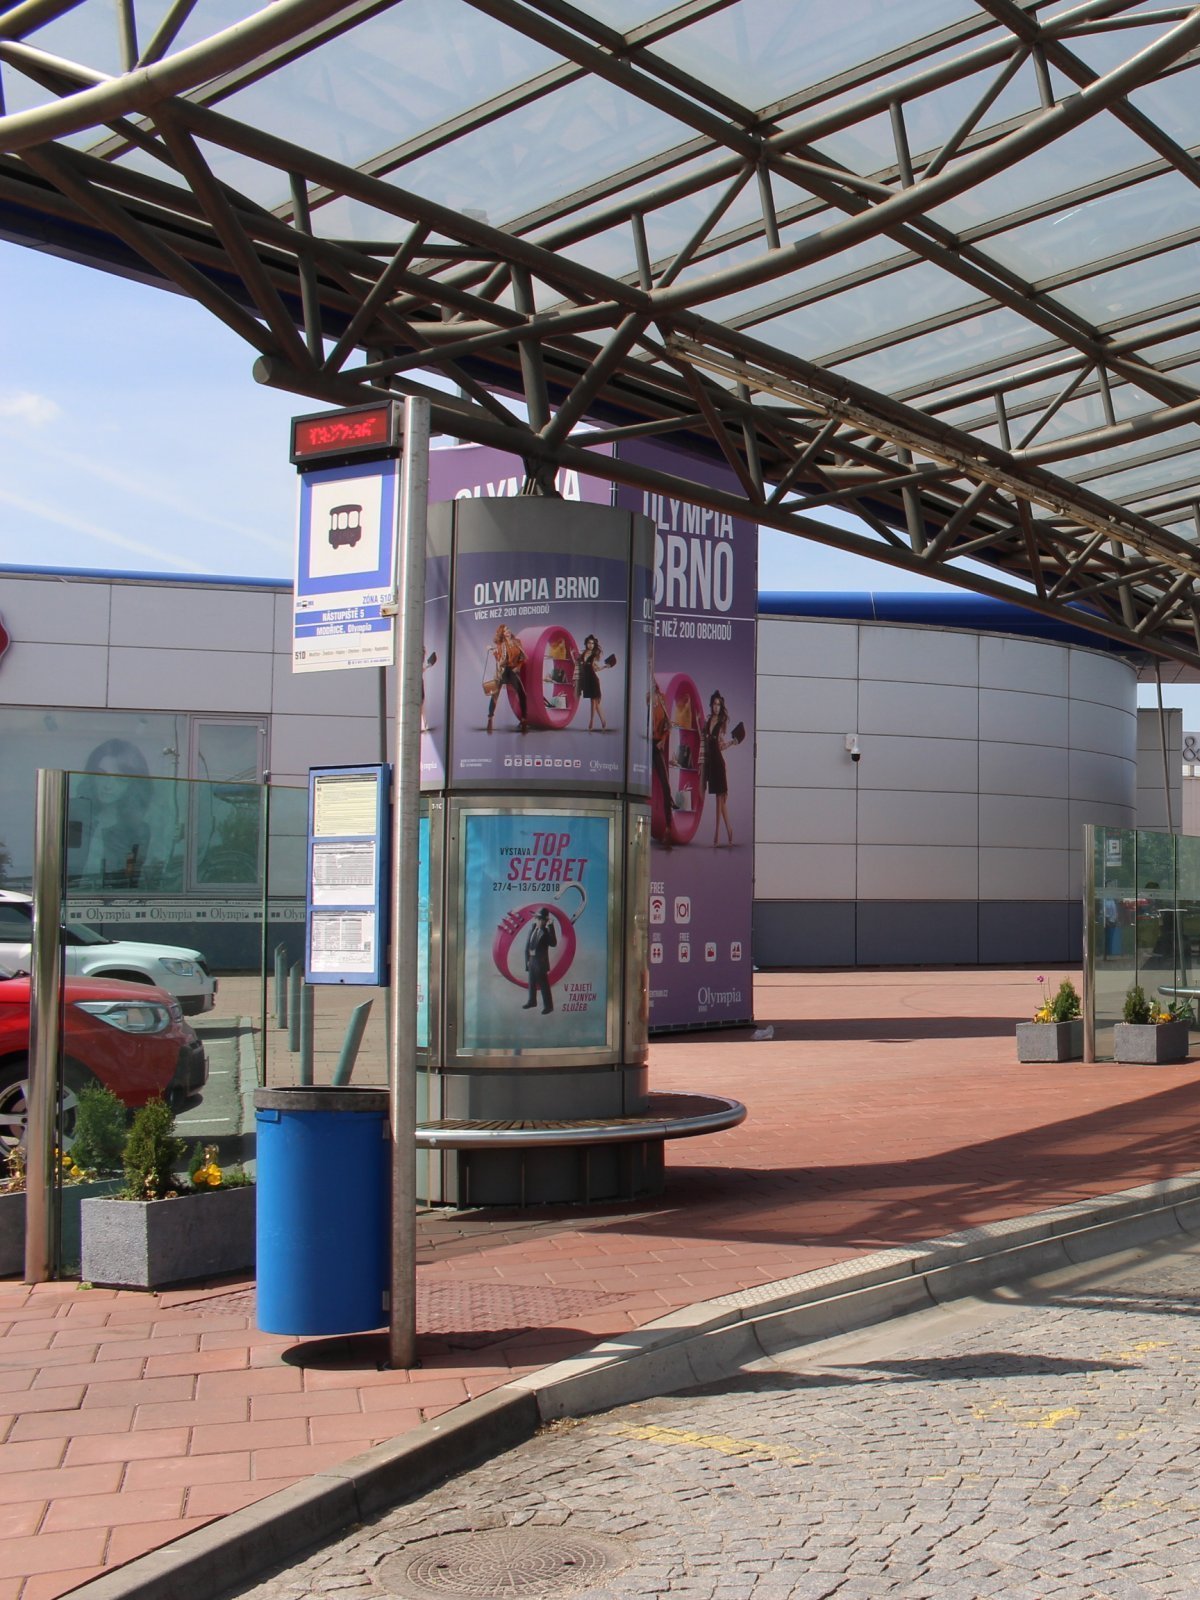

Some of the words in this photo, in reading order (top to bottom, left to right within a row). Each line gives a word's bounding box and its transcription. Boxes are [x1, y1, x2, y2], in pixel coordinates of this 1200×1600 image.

[654, 533, 734, 612] BRNO
[474, 577, 549, 606] OLYMPIA
[555, 576, 599, 599] BRNO
[360, 609, 365, 618] 5
[474, 608, 489, 620] VÍCE
[489, 605, 503, 619] NEŽ
[504, 605, 518, 617] 200
[518, 603, 550, 616] OBCHODŮ
[661, 618, 678, 638] NEŽ
[679, 621, 695, 639] 200
[696, 621, 732, 641] OBCHODŮ
[295, 651, 306, 660] 510
[500, 846, 531, 856] VÝSTAVA
[532, 832, 571, 857] TOP
[508, 858, 588, 882] SECRET
[650, 882, 665, 894] FREE
[86, 907, 131, 921] Olympia
[150, 908, 192, 920] Olympia
[564, 983, 569, 992] V
[698, 986, 742, 1007] Olympia
